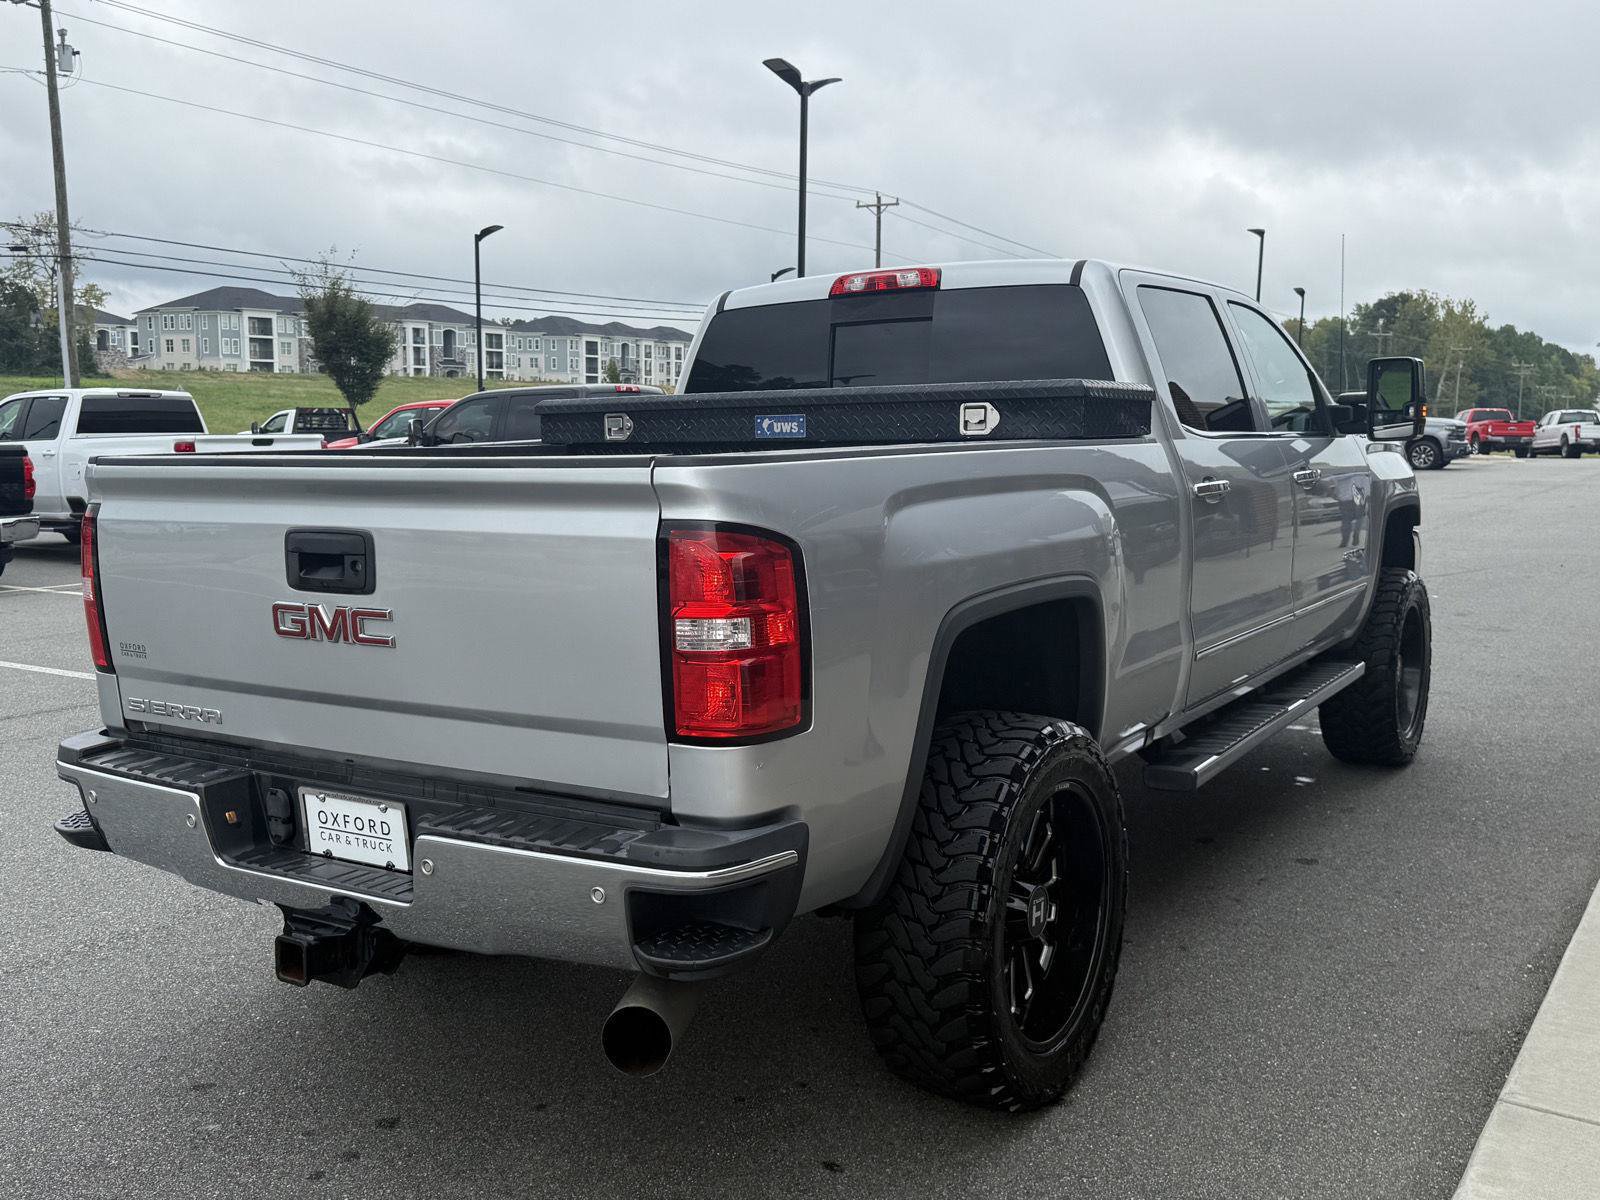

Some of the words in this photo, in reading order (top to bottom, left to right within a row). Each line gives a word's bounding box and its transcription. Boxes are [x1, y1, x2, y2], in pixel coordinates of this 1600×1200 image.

[773, 421, 799, 433] UWS
[272, 600, 396, 648] GMC
[120, 641, 147, 652] OXFORD
[128, 697, 222, 724] SIERRA
[317, 810, 391, 836] OXFORD
[320, 831, 341, 845] CAR
[345, 835, 352, 846] &
[354, 837, 393, 854] TRUCK
